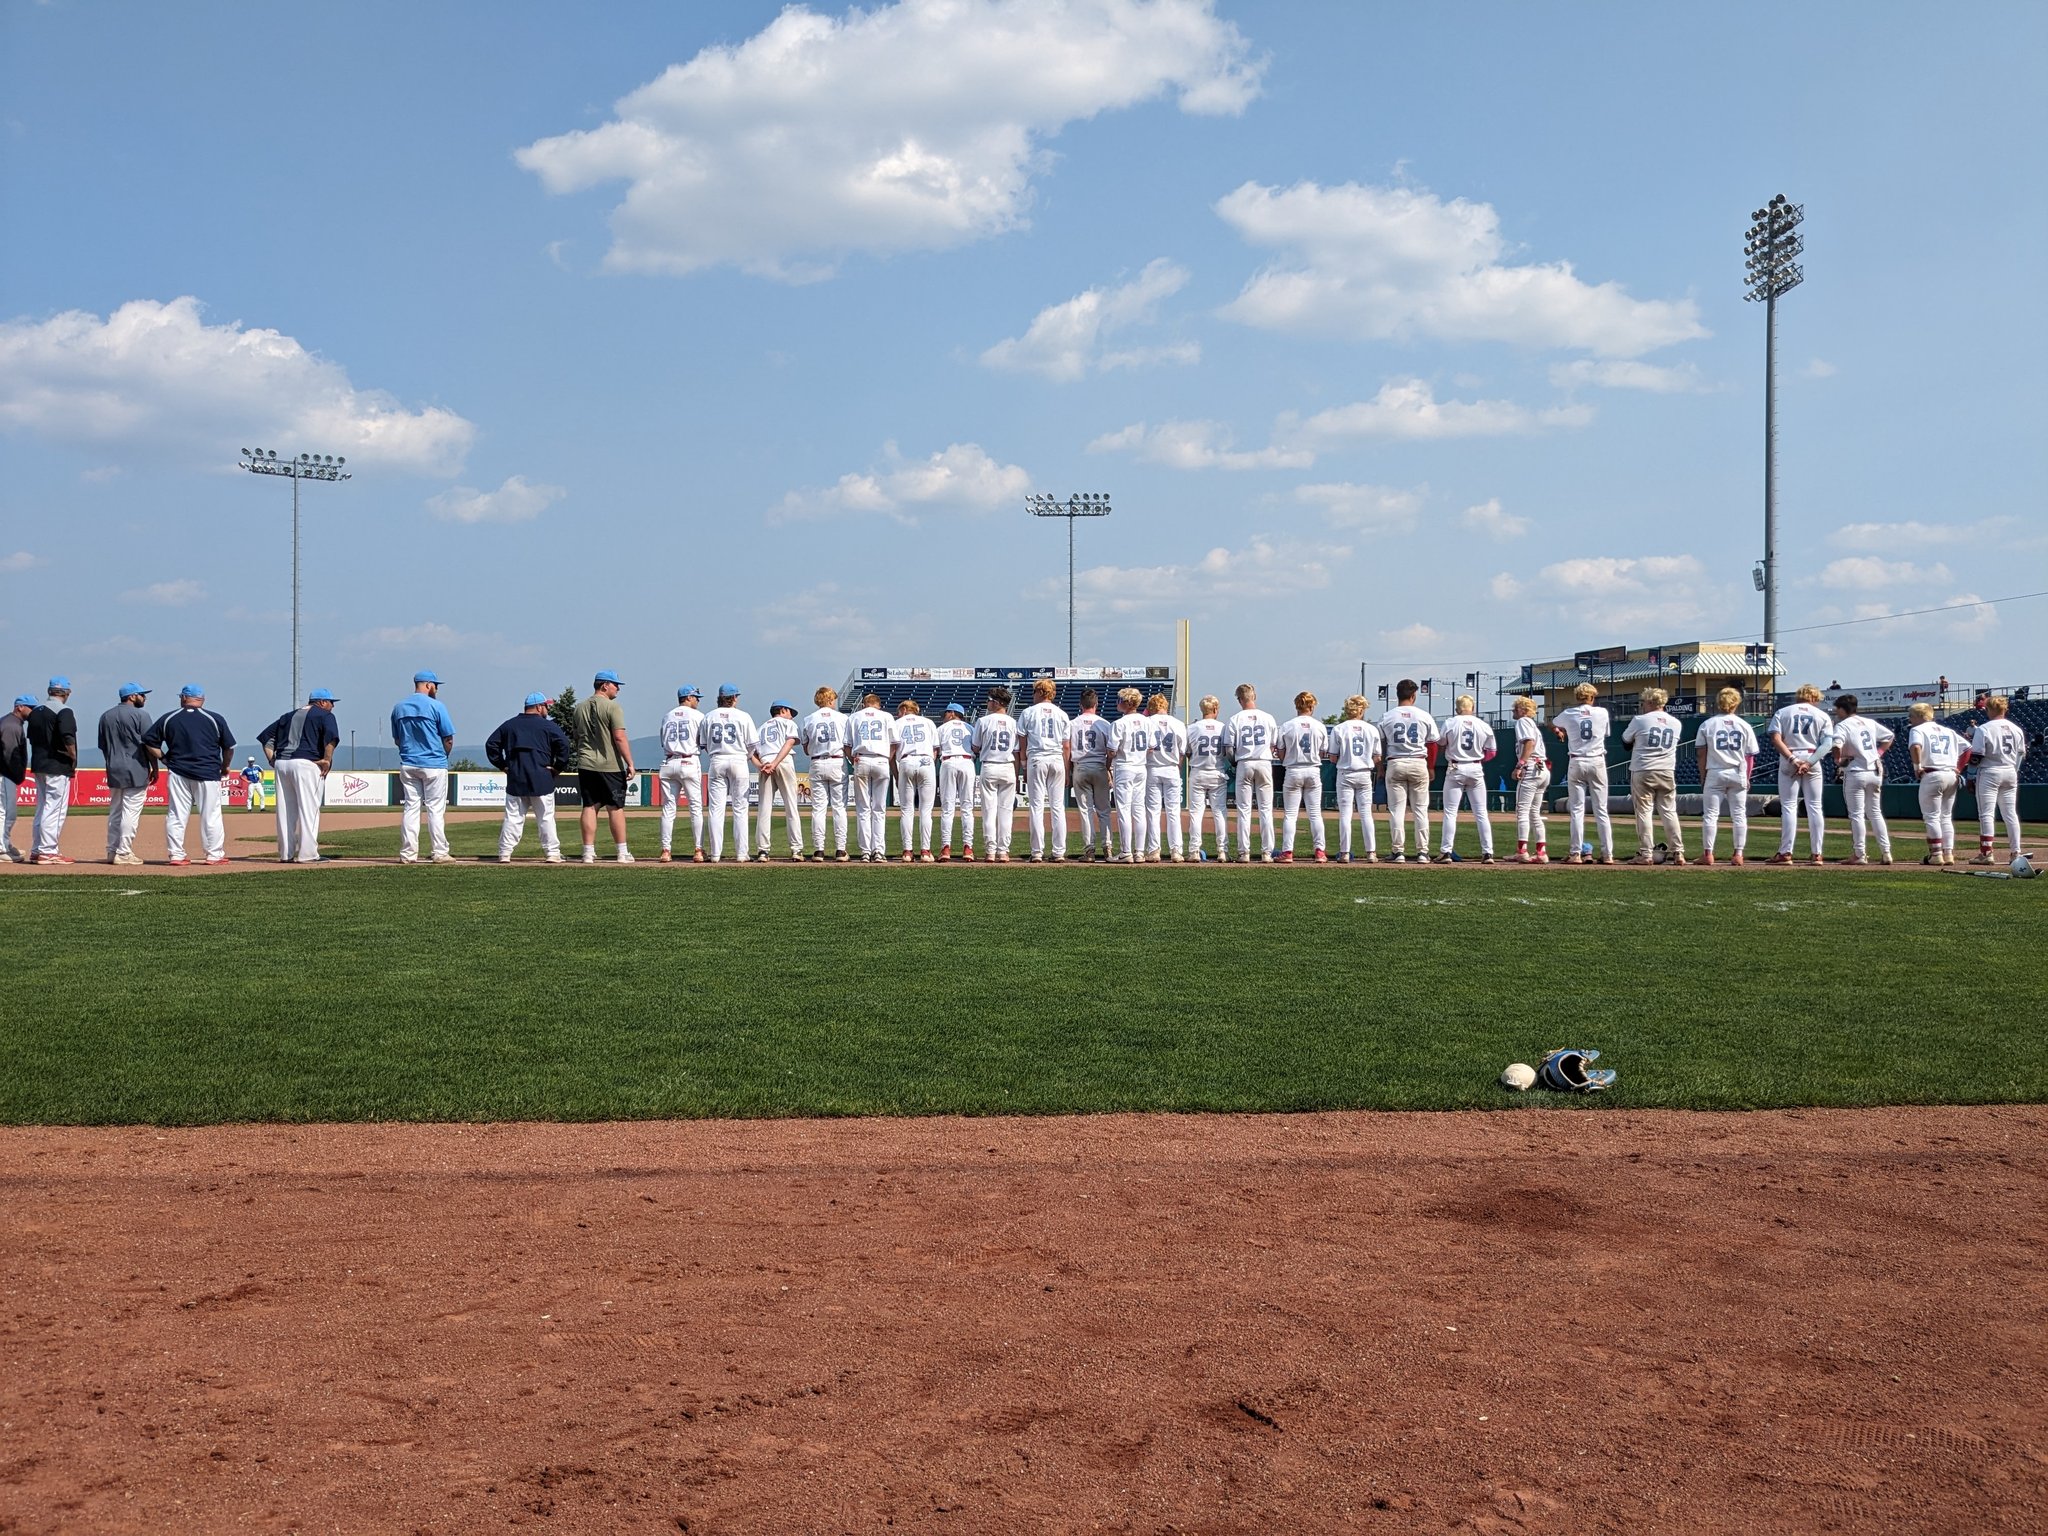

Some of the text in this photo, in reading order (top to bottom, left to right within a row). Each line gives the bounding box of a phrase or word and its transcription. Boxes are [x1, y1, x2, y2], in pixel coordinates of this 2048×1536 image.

[1903, 691, 1936, 701] MAXPREPS
[1666, 704, 1692, 712] SPALDING
[711, 722, 736, 744] 33
[816, 722, 836, 743] 31
[858, 720, 882, 740] 42
[902, 724, 925, 744] 45
[1041, 718, 1054, 738] 11
[1394, 723, 1418, 743] 24
[1580, 720, 1592, 740] 8
[1793, 714, 1813, 734] 17
[991, 731, 1010, 751] 19
[1078, 730, 1096, 750] 13
[1131, 731, 1147, 752] 10
[1154, 731, 1173, 752] 14
[1242, 725, 1265, 745] 22
[1299, 733, 1311, 753] 4
[1461, 731, 1474, 751] 3
[1648, 727, 1674, 749] 60
[1716, 730, 1742, 751] 23
[1860, 731, 1872, 750] 2
[1930, 735, 1950, 754] 27
[2002, 735, 2012, 754] 5
[1198, 736, 1222, 756] 29
[1353, 736, 1363, 756] 6
